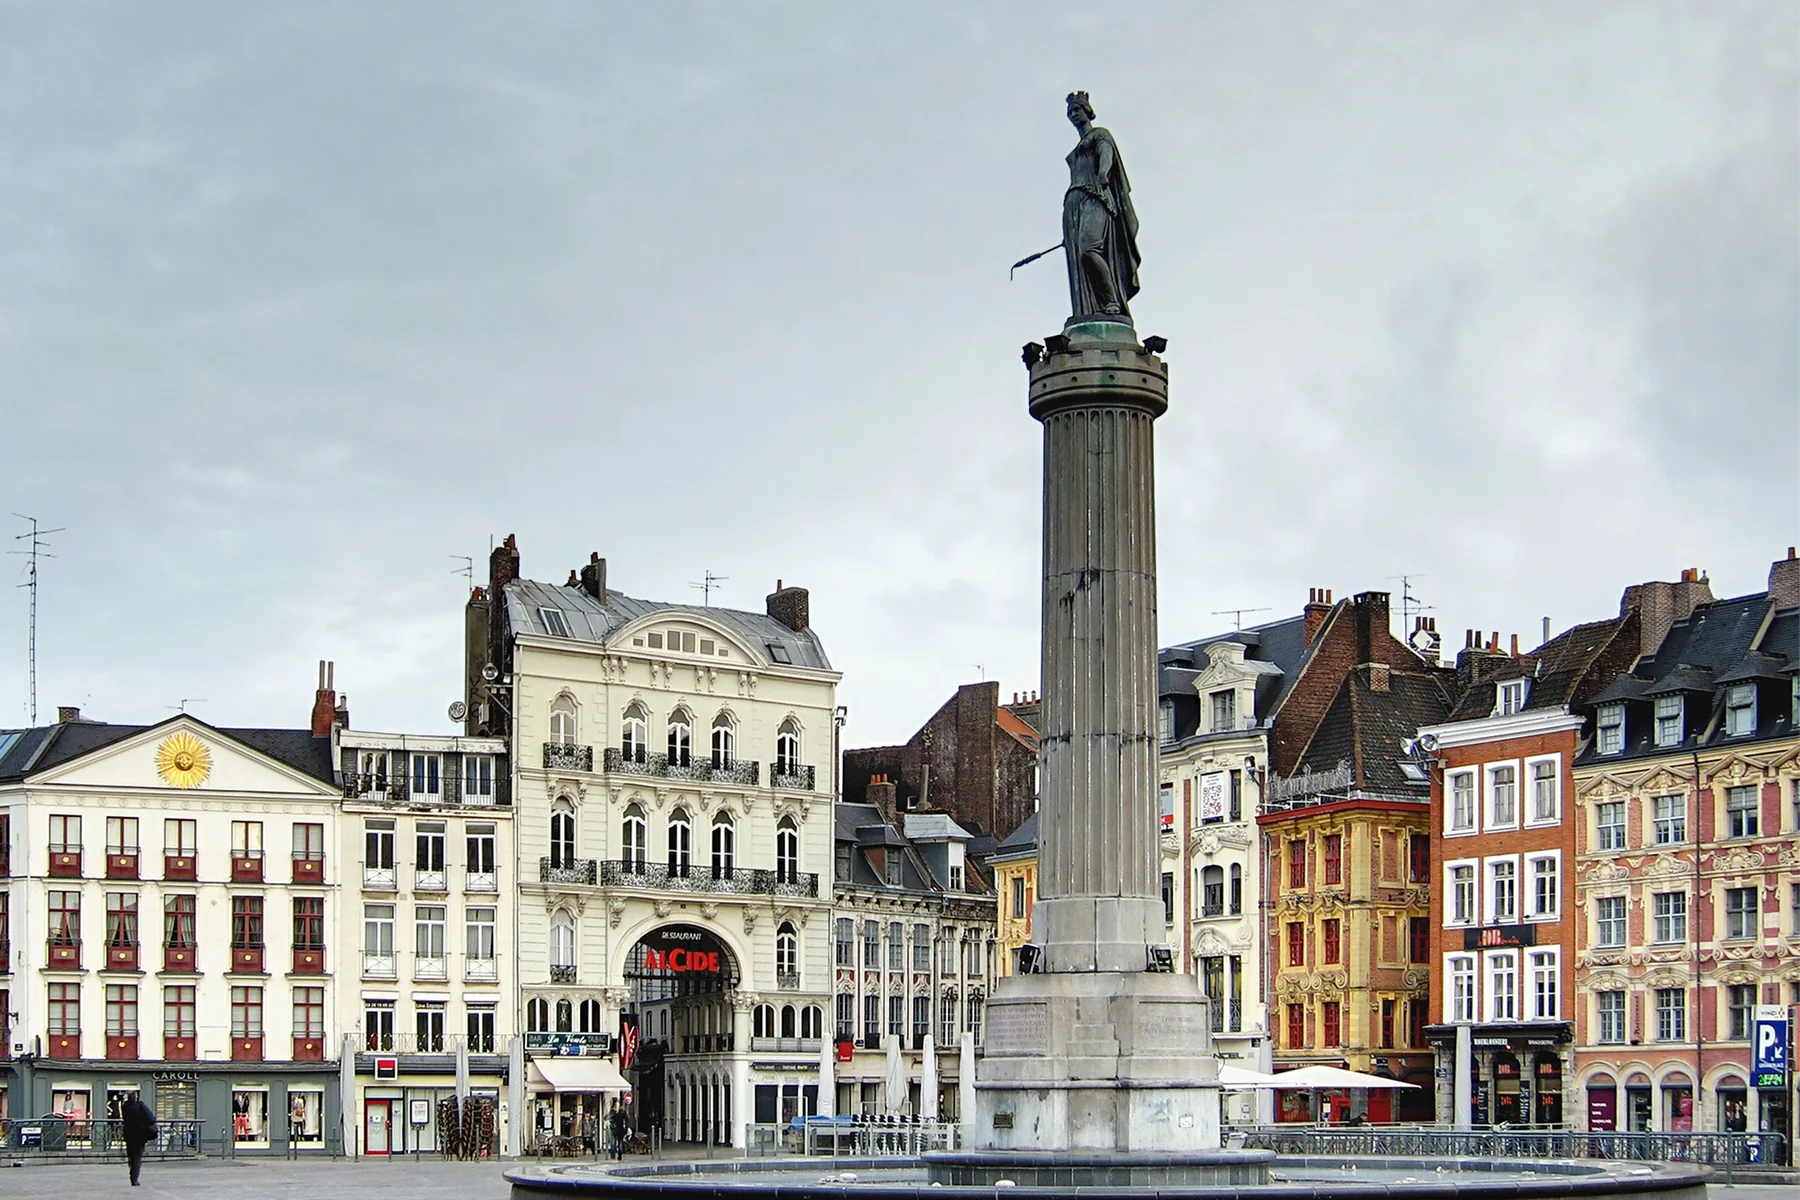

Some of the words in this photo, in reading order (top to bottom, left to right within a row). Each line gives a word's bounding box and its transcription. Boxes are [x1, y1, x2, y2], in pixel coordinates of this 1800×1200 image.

[661, 931, 702, 940] RESTAURANT
[644, 948, 719, 972] ALCIDE
[587, 1035, 606, 1043] TABAC
[1759, 1024, 1776, 1059] P
[1213, 1052, 1245, 1060] NCEL
[152, 1071, 201, 1081] CAROLL
